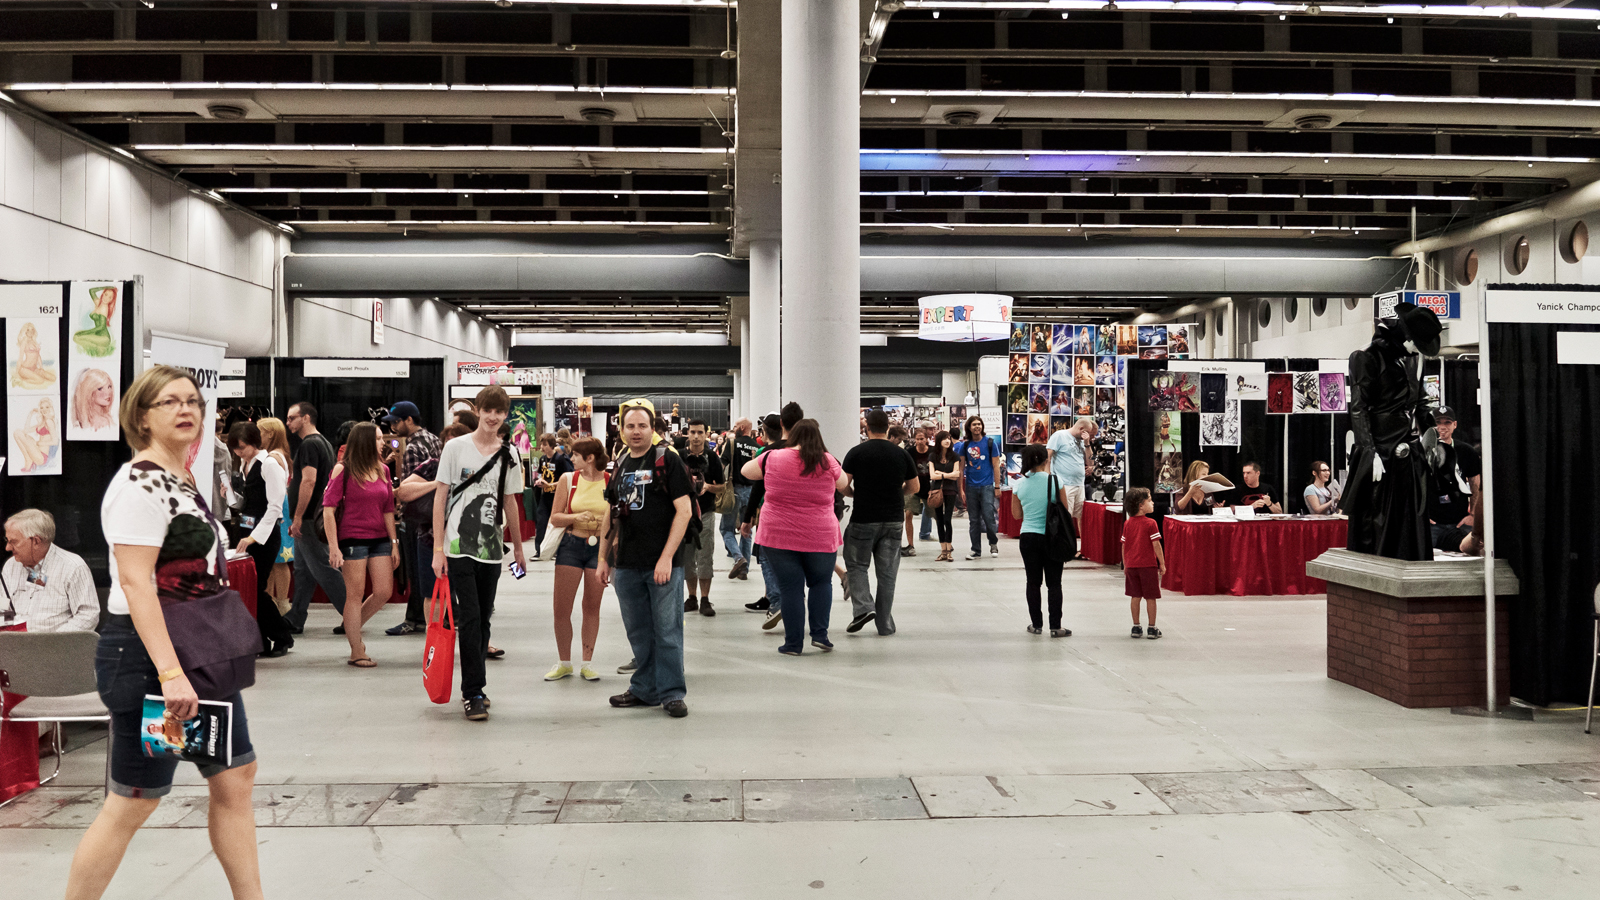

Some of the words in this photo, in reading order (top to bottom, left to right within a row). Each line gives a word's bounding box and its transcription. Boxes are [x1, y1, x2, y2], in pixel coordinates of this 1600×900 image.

[1418, 296, 1446, 305] MEGA
[39, 306, 59, 314] 1621
[1537, 302, 1564, 311] Yanick
[923, 305, 974, 323] EXPERT
